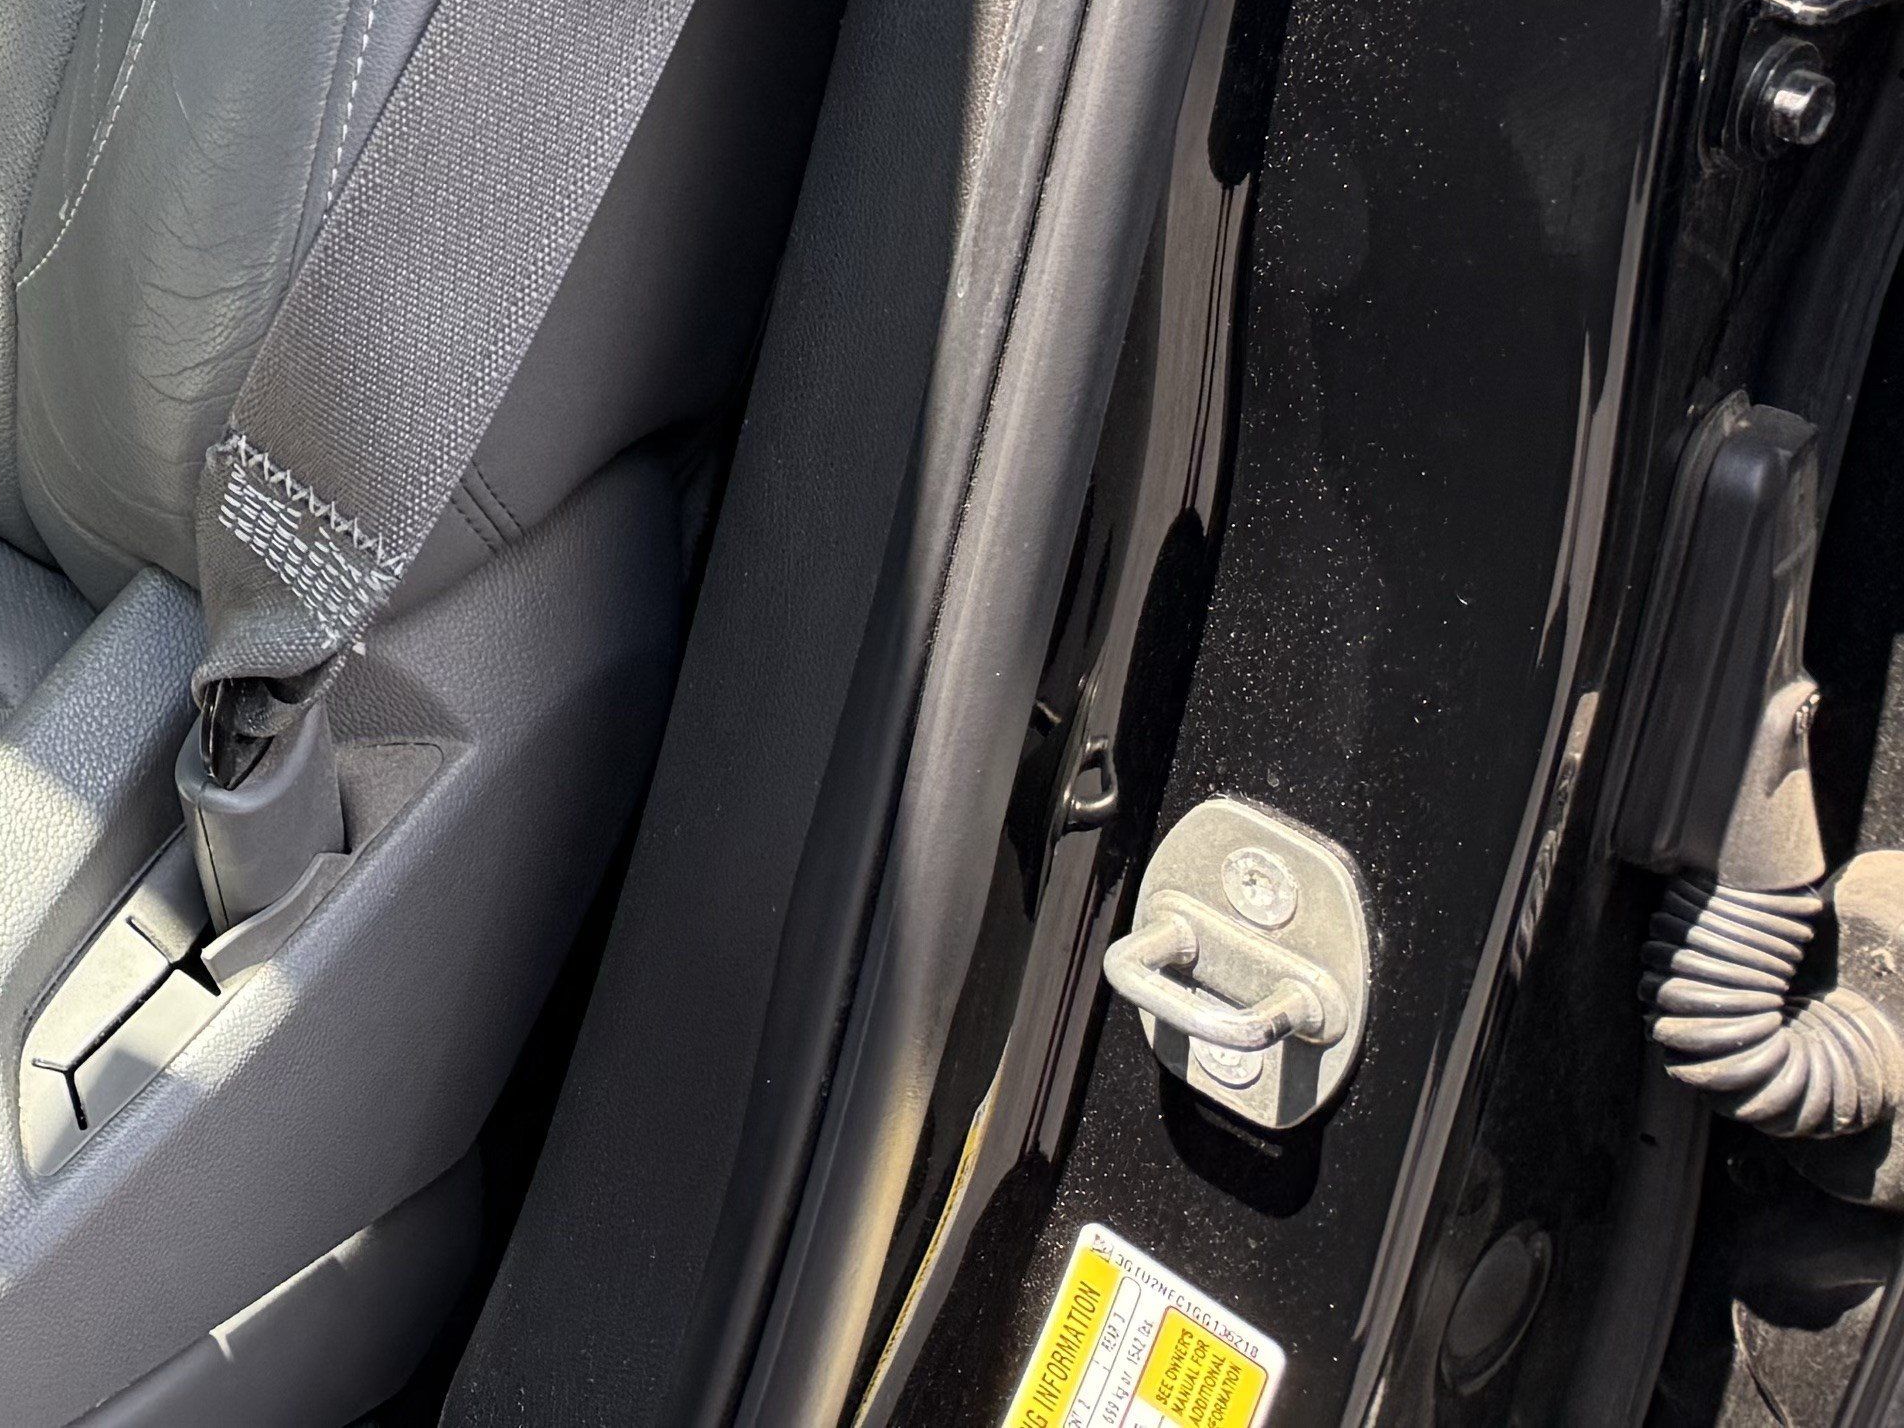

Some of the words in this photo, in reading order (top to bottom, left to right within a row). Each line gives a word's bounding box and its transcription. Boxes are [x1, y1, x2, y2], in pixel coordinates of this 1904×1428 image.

[1033, 1280, 1101, 1412] INFORMATION
[1171, 1367, 1200, 1417] MANUAL
[1191, 1339, 1210, 1367] FOR
[1156, 1379, 1174, 1406] SEE
[1188, 1354, 1226, 1428] ADDITIONAL
